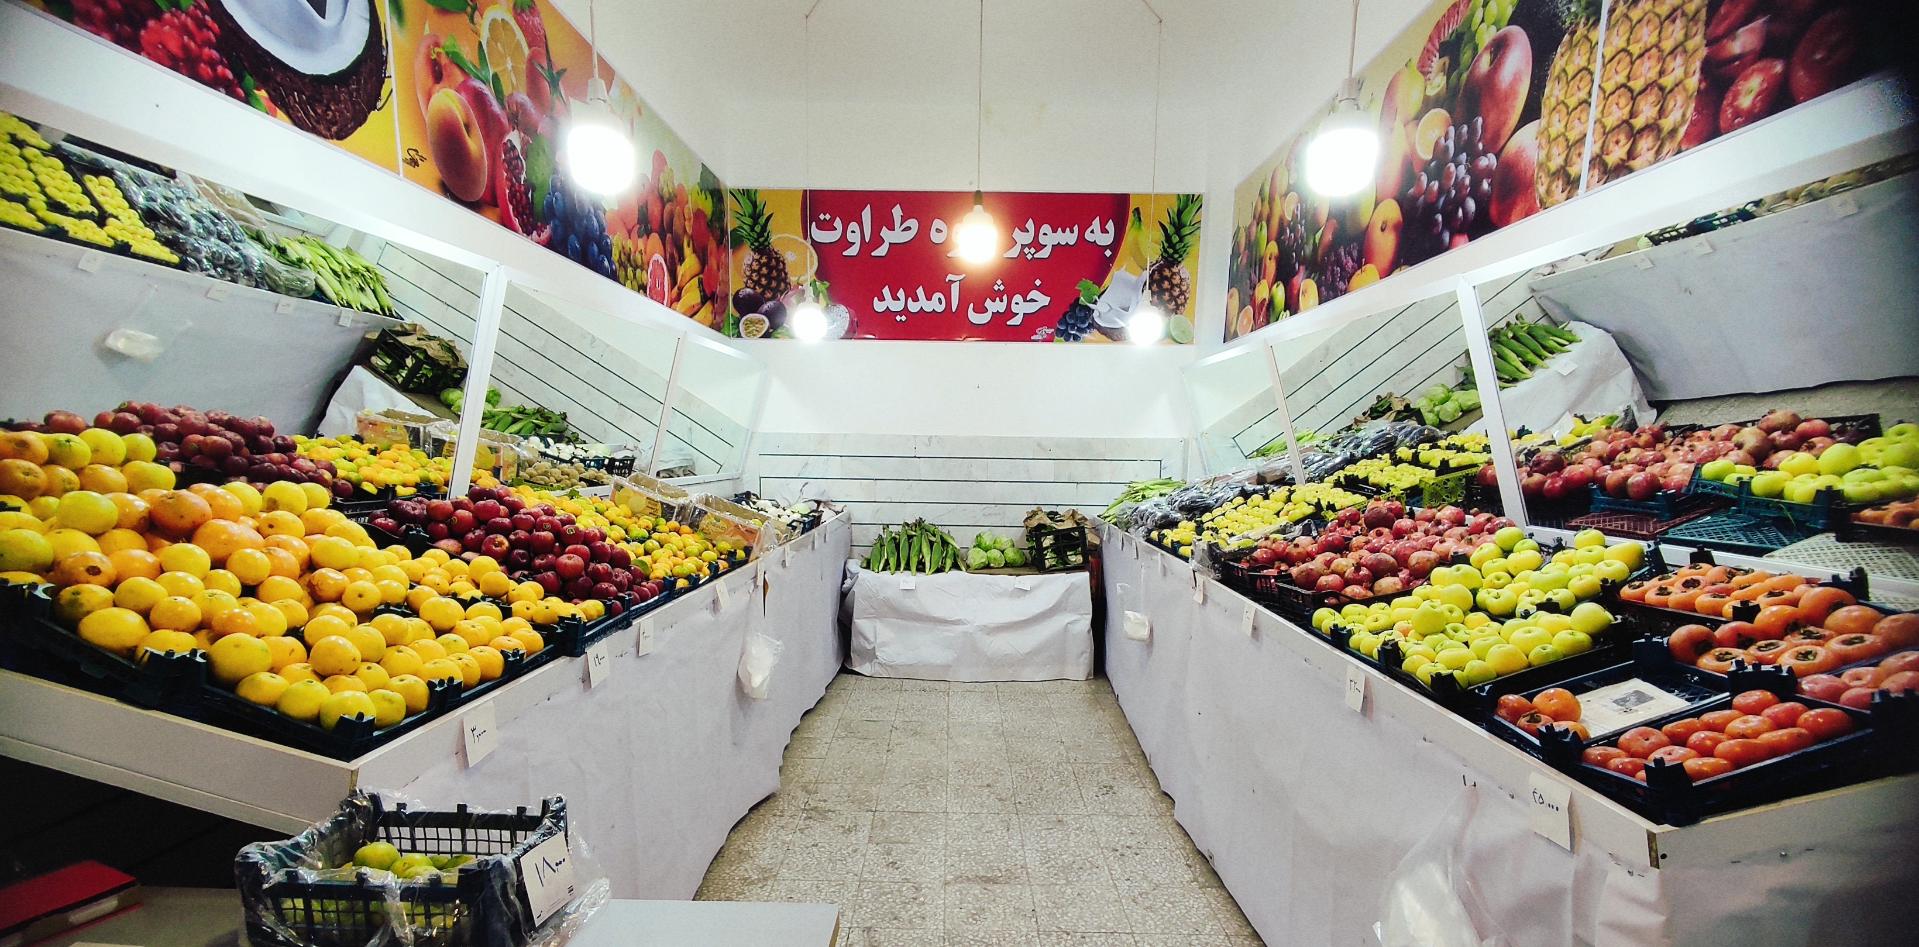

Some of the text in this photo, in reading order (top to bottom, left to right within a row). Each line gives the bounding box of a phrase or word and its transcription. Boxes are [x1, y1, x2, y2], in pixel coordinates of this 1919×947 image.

[811, 203, 919, 257] طراوت
[1003, 217, 1079, 260] سوپر
[1084, 215, 1115, 258] به
[873, 273, 1051, 326] خوش آمدید
